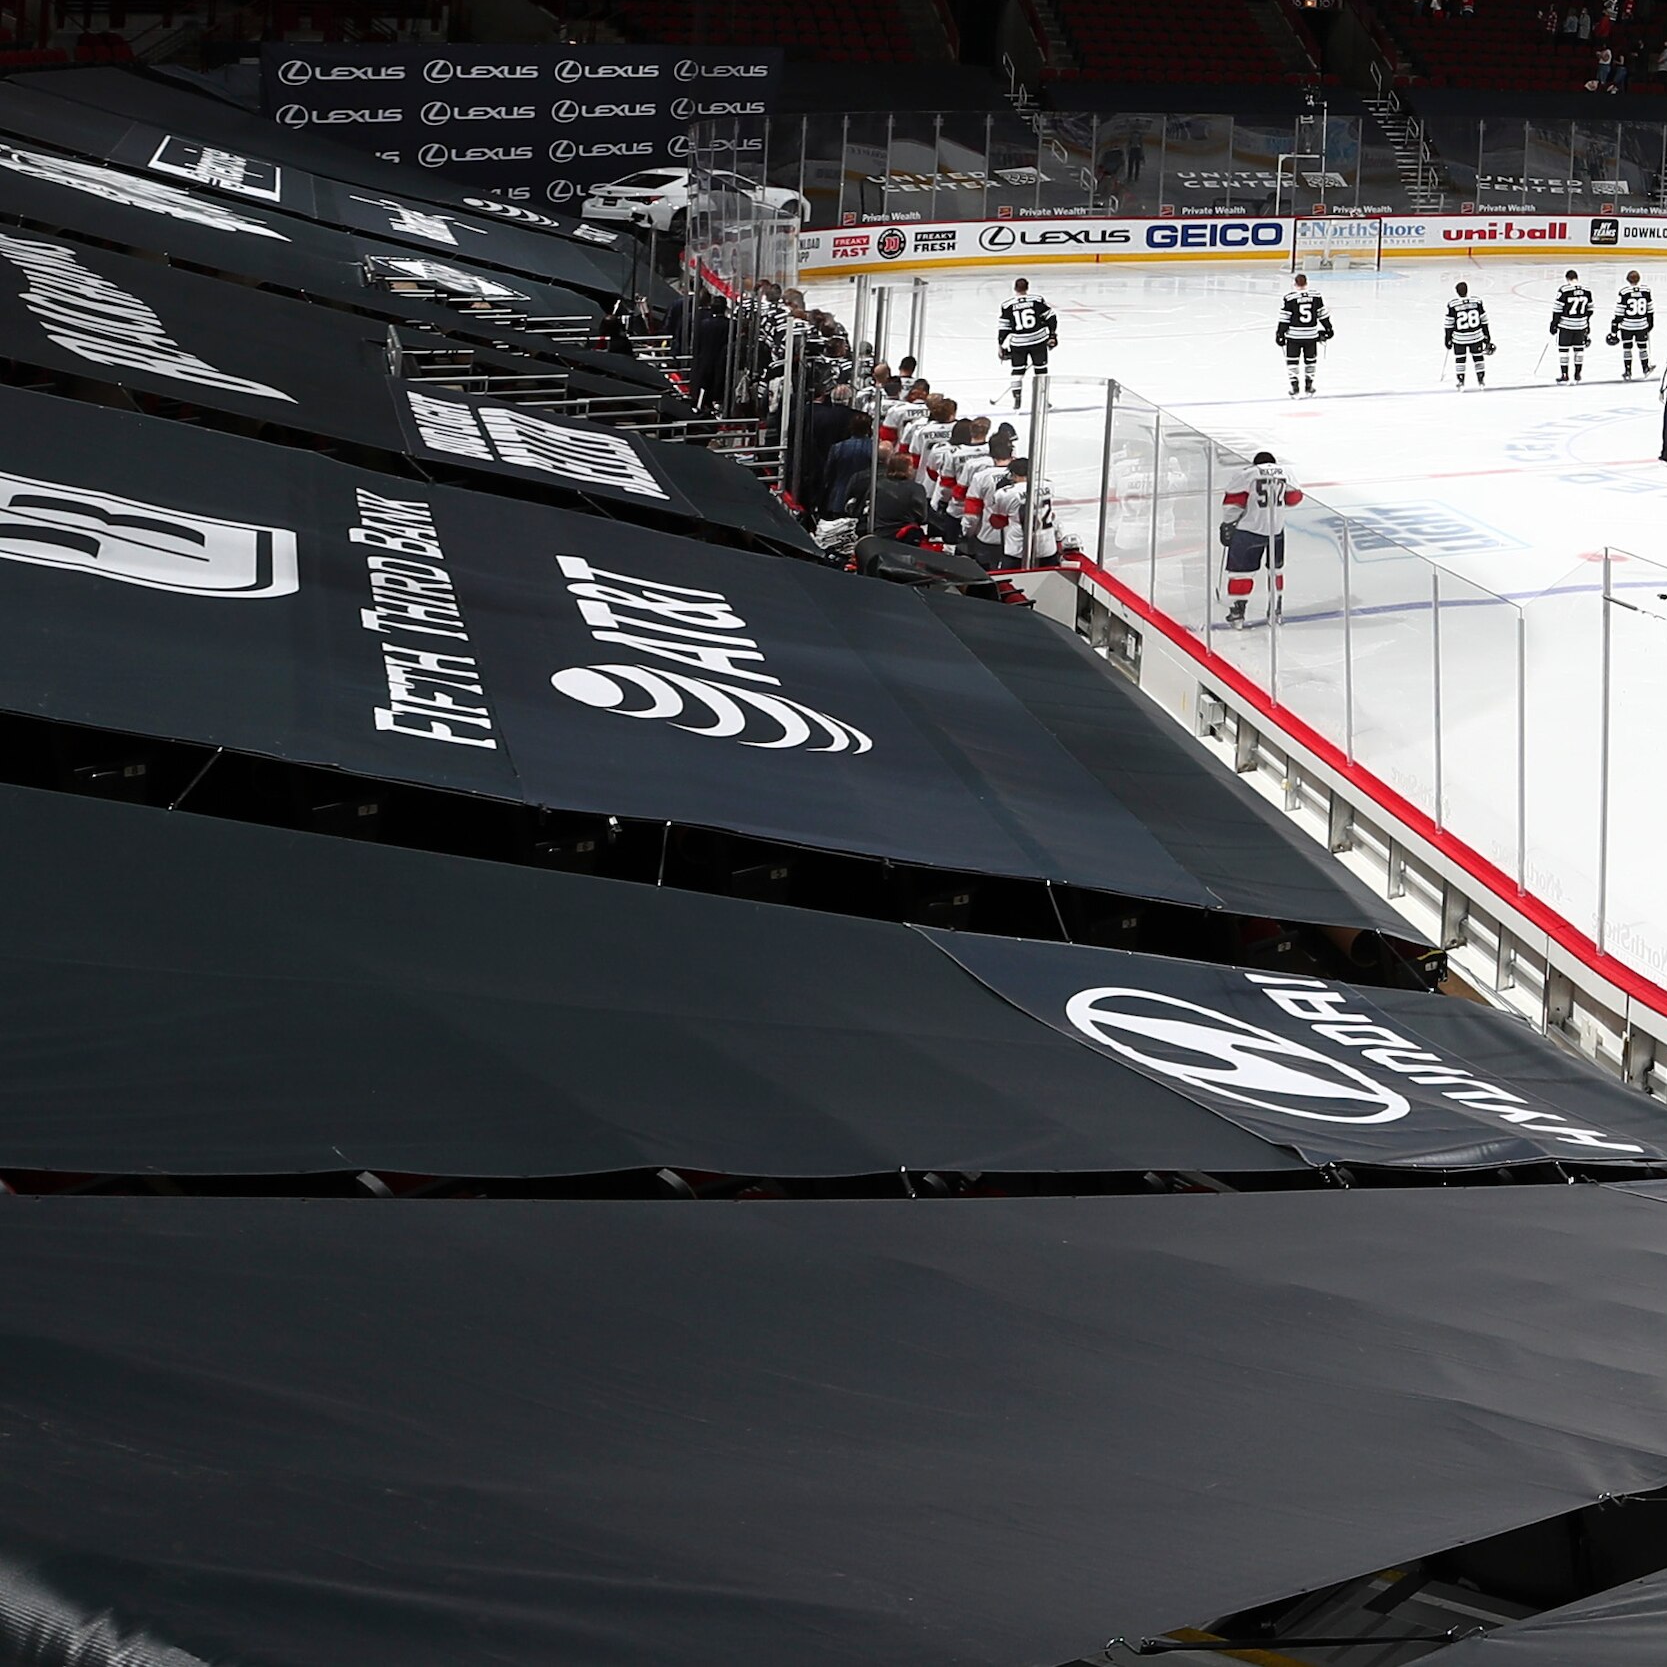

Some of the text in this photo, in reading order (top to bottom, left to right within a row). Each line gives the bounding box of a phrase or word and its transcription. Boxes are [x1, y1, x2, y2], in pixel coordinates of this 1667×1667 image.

[313, 65, 406, 81] LEXUS
[455, 64, 539, 79] LEXUS
[582, 63, 659, 78] LEXUS
[699, 63, 769, 78] LEXUS
[311, 107, 403, 124] LEXUS
[453, 104, 536, 121] LEXUS
[579, 102, 656, 117] LEXUS
[695, 100, 765, 116] LEXUS
[451, 145, 533, 162] LEXUS
[577, 141, 653, 157] LEXUS
[1019, 206, 1087, 217] Private Wealth
[1181, 205, 1246, 215] Private Wealth
[1478, 203, 1536, 214] Private Wealth
[861, 211, 922, 223] Private Wealth
[915, 231, 954, 241] FREAKY
[1020, 229, 1131, 245] LEXUS
[1145, 223, 1283, 248] GEICO
[1443, 222, 1567, 240] uni-ball
[834, 236, 869, 247] FREAKY
[914, 240, 957, 253] FRESH
[832, 246, 870, 259] FAST
[1298, 303, 1312, 323] 5
[1567, 296, 1589, 315] 77
[1625, 298, 1647, 315] 38
[1012, 308, 1036, 331] 16
[1456, 310, 1479, 330] 28
[1255, 478, 1286, 508] 52
[349, 487, 498, 749] FIFTH THIRD BANK
[555, 554, 783, 686] AT&T
[1244, 972, 1643, 1156] HYUNDAI
